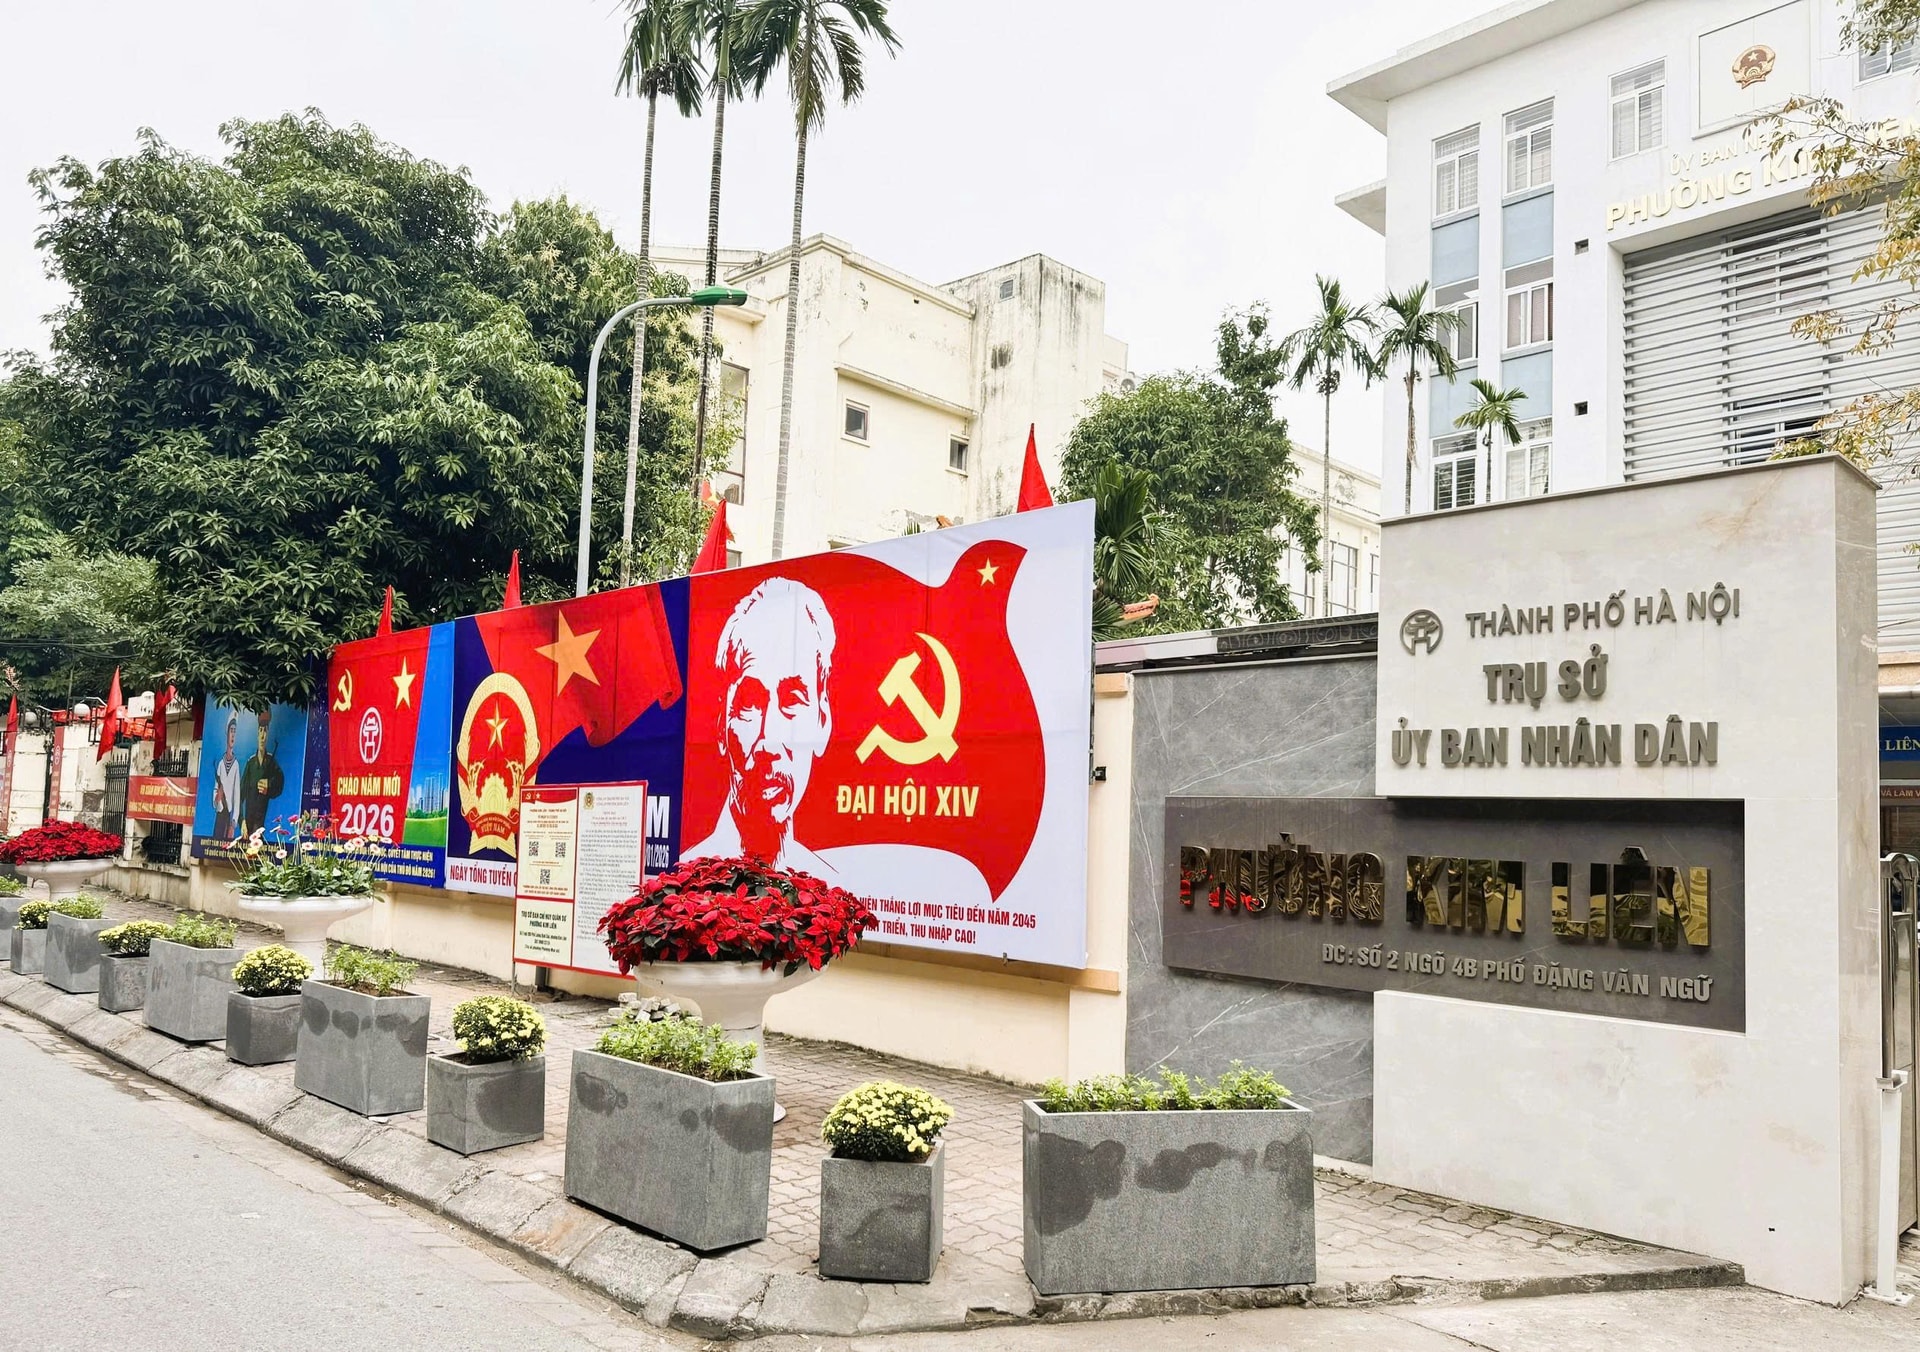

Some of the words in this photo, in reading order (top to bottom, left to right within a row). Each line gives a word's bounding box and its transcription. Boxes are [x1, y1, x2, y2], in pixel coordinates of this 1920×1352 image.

[1670, 153, 1694, 176] ỦY
[1700, 141, 1738, 167] BAN
[1606, 169, 1751, 231] PHƯỜNG
[1762, 144, 1832, 187] KI
[1465, 603, 1553, 638] THÀNH
[1564, 589, 1627, 631] PHỐ
[1634, 588, 1677, 626] HÀ
[1687, 582, 1741, 626] NỘI
[1482, 661, 1548, 710] TRỤ
[1557, 643, 1609, 701] SỞ
[1391, 716, 1433, 767] ỦY
[1441, 727, 1509, 767] BAN
[1521, 716, 1622, 767] NHÂN
[1634, 714, 1719, 765] DÂN
[337, 773, 359, 796] CHÀO
[361, 772, 381, 796] NĂM
[382, 771, 401, 796] MỚI
[836, 785, 875, 821] ĐẠI
[883, 778, 927, 823] HỘI
[935, 786, 980, 817] XIV
[340, 803, 395, 838] 2026
[450, 862, 468, 882] NGÀY
[469, 861, 487, 884] TỔNG
[489, 864, 512, 887] TUYỂN
[1180, 832, 1386, 922] PHƯỜNG
[1406, 856, 1526, 936] KIM
[1551, 845, 1711, 948] LIÊN
[880, 896, 906, 915] THẮNG
[908, 901, 921, 919] LỢI
[924, 903, 943, 920] MỤC
[945, 903, 965, 921] TIÊU
[967, 903, 985, 923] ĐẾN
[988, 907, 1010, 926] NĂM
[1012, 912, 1036, 929] 2045
[883, 917, 908, 937] TRIỂN,
[910, 923, 926, 938] THU
[928, 924, 952, 943] NHẬP
[954, 928, 976, 944] CAO!
[1356, 942, 1384, 968] SỐ
[1386, 951, 1399, 970] 2
[1404, 951, 1446, 976] NGÕ
[1451, 957, 1477, 978] 4B
[1482, 956, 1526, 983] PHỐ
[1533, 961, 1594, 991] ĐẶNG
[1602, 967, 1649, 995] VĂN
[1660, 974, 1715, 1003] NGỮ
